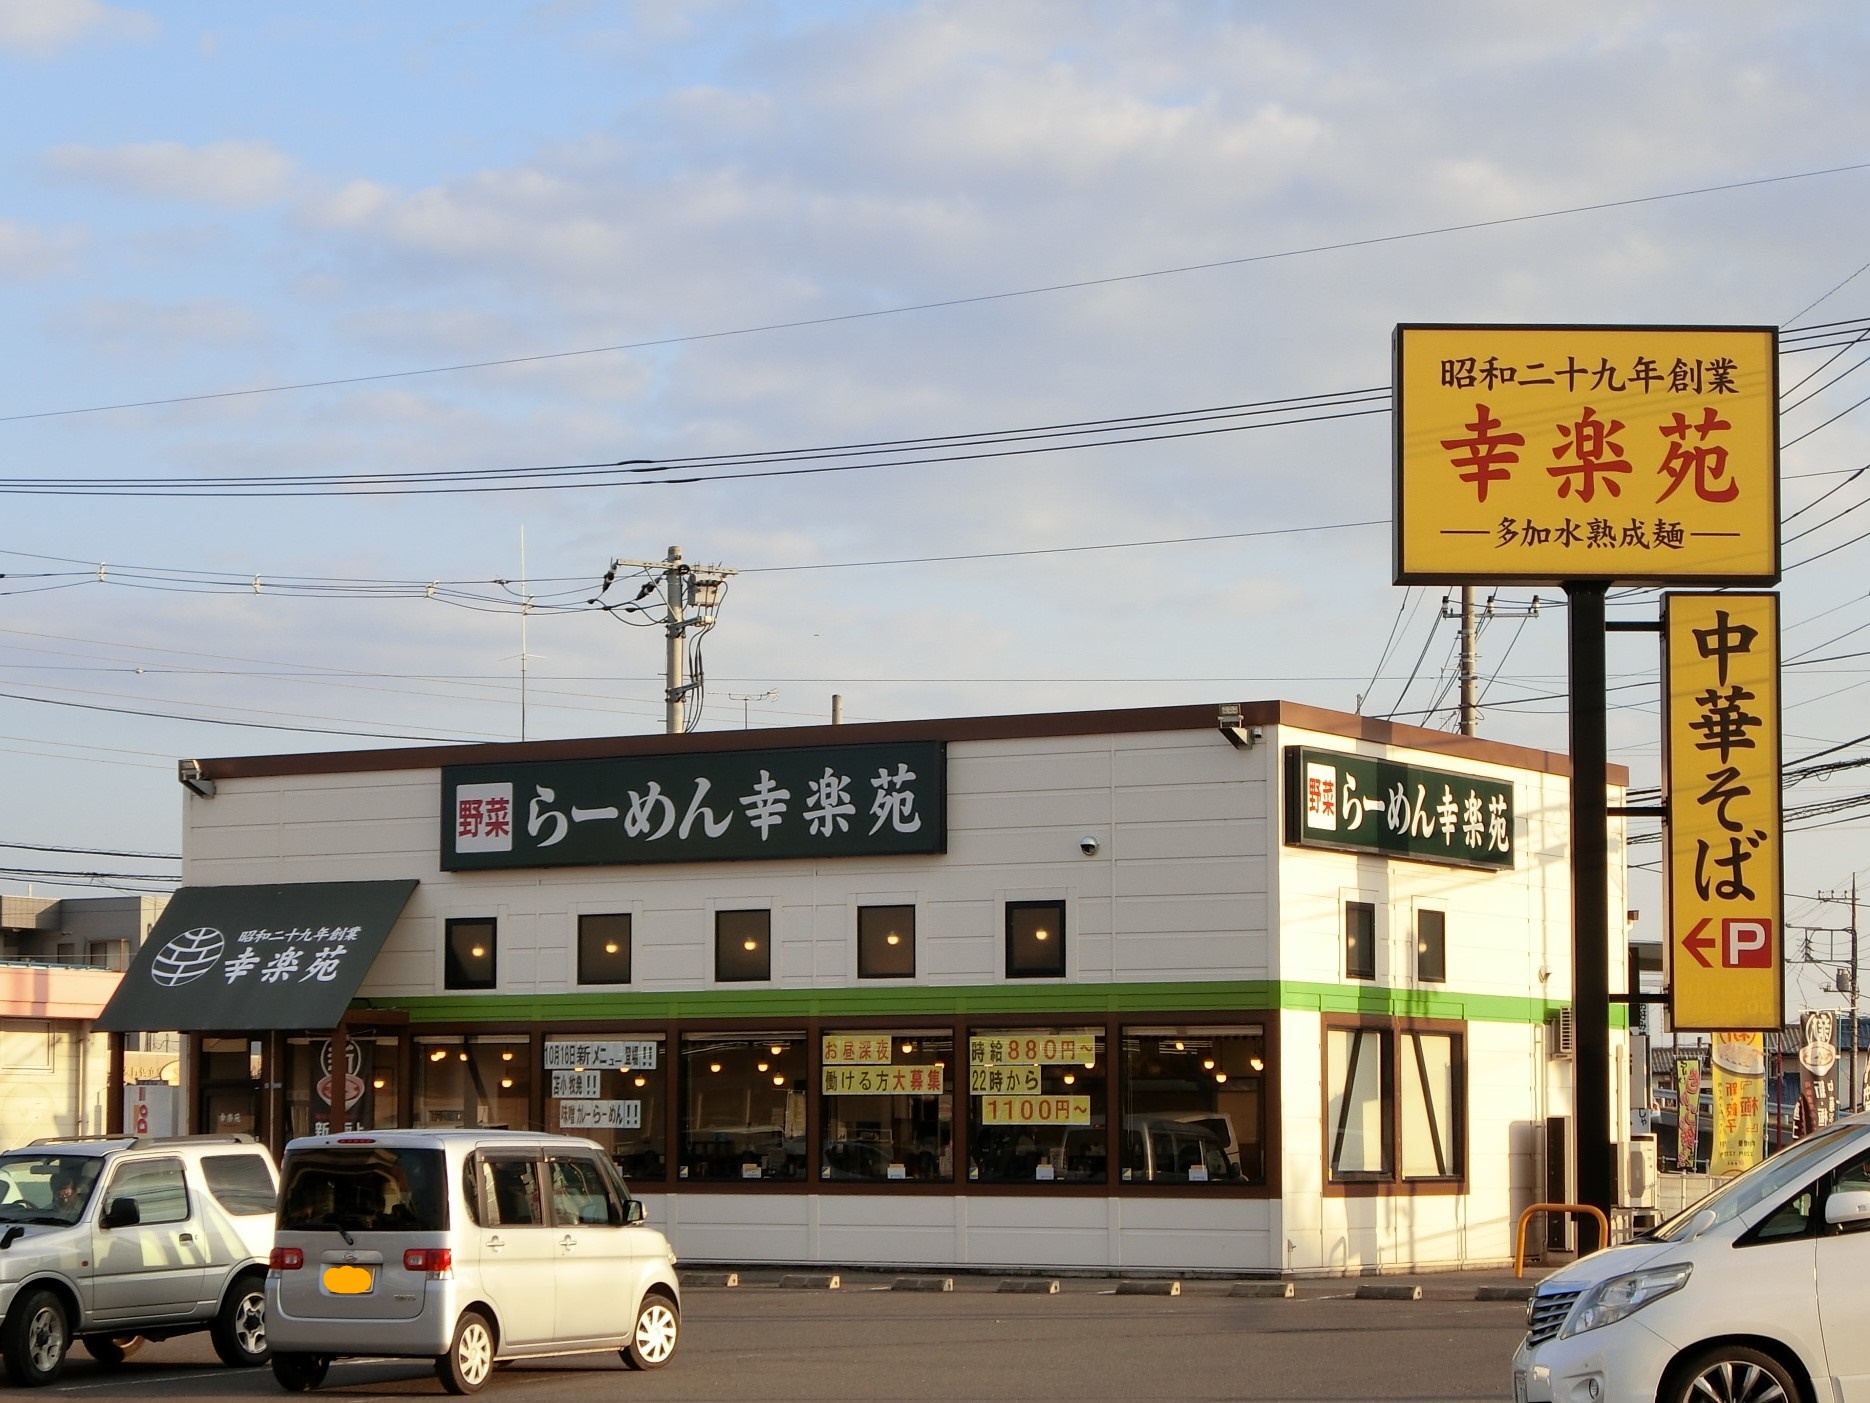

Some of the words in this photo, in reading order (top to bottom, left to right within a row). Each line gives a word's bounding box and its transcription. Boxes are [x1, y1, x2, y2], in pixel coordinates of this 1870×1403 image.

[1440, 356, 1740, 394] 昭和二十九年創業
[1440, 403, 1740, 504] 幸楽苑
[1494, 517, 1685, 549] 多加水熟成麺
[1689, 610, 1768, 901] 中華そば
[458, 797, 510, 838] 野菜
[527, 762, 922, 847] らーめん幸楽苑
[1309, 778, 1334, 817] 野菜
[1342, 772, 1510, 852] らーめん幸楽苑
[237, 926, 362, 943] 昭和二十九年創業
[1729, 922, 1766, 965] P
[224, 945, 348, 984] 幸楽苑
[825, 1039, 889, 1061] お昼深夜
[825, 1069, 941, 1092] 働ける方大募集
[972, 1070, 1039, 1092] 22時から
